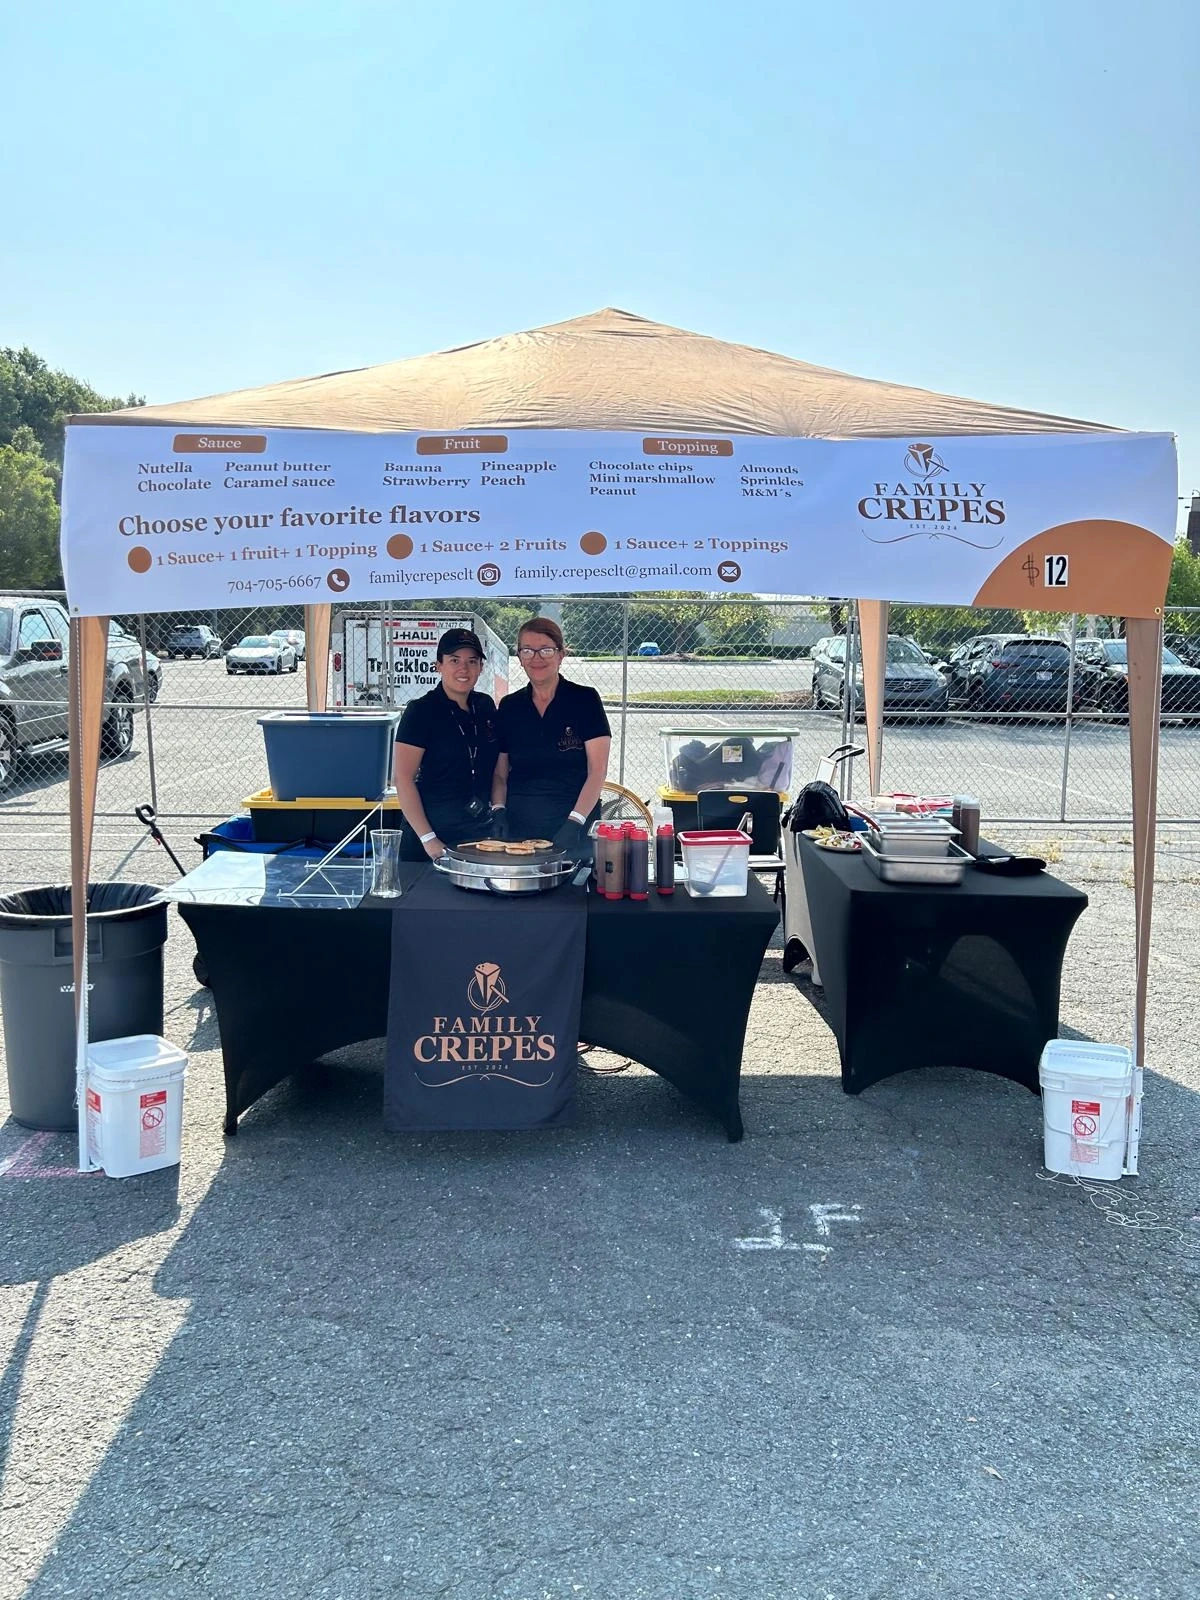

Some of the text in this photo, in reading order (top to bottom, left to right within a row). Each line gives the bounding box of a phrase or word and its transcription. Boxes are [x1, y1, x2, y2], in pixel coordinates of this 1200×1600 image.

[198, 437, 241, 449] Sauce
[443, 437, 480, 450] Fruit
[658, 440, 718, 454] Topping
[138, 462, 332, 474] Nutella Peanut butter
[384, 461, 557, 473] Banana Pineapple
[589, 461, 798, 474] Chocolate chips Almonds
[138, 476, 336, 493] Chocolate Caramel sauce
[383, 475, 526, 488] Strawberry Peach
[589, 473, 804, 488] Mini marshmallow Sprinkles
[590, 486, 637, 496] Peanut
[874, 483, 986, 497] FAMILY
[857, 497, 1006, 525] CREPES
[118, 506, 480, 536] Choose your favorite flavors
[420, 538, 567, 553] 1 Sauce+ 2 Fruits
[614, 537, 789, 553] 1 Sauce+ 2 Toppings
[157, 543, 378, 566] 1 Sauce+ 1 fruit+ 1 Topping
[368, 568, 474, 585] familycrepesclt
[513, 563, 713, 581] family.crepesclt@gmail.com
[1021, 553, 1067, 588] $ 12
[227, 576, 321, 593] 704-705-6667
[399, 648, 428, 657] Move
[415, 675, 437, 684] Your
[433, 1016, 542, 1034] FAMILY
[413, 1035, 556, 1063] CREPES
